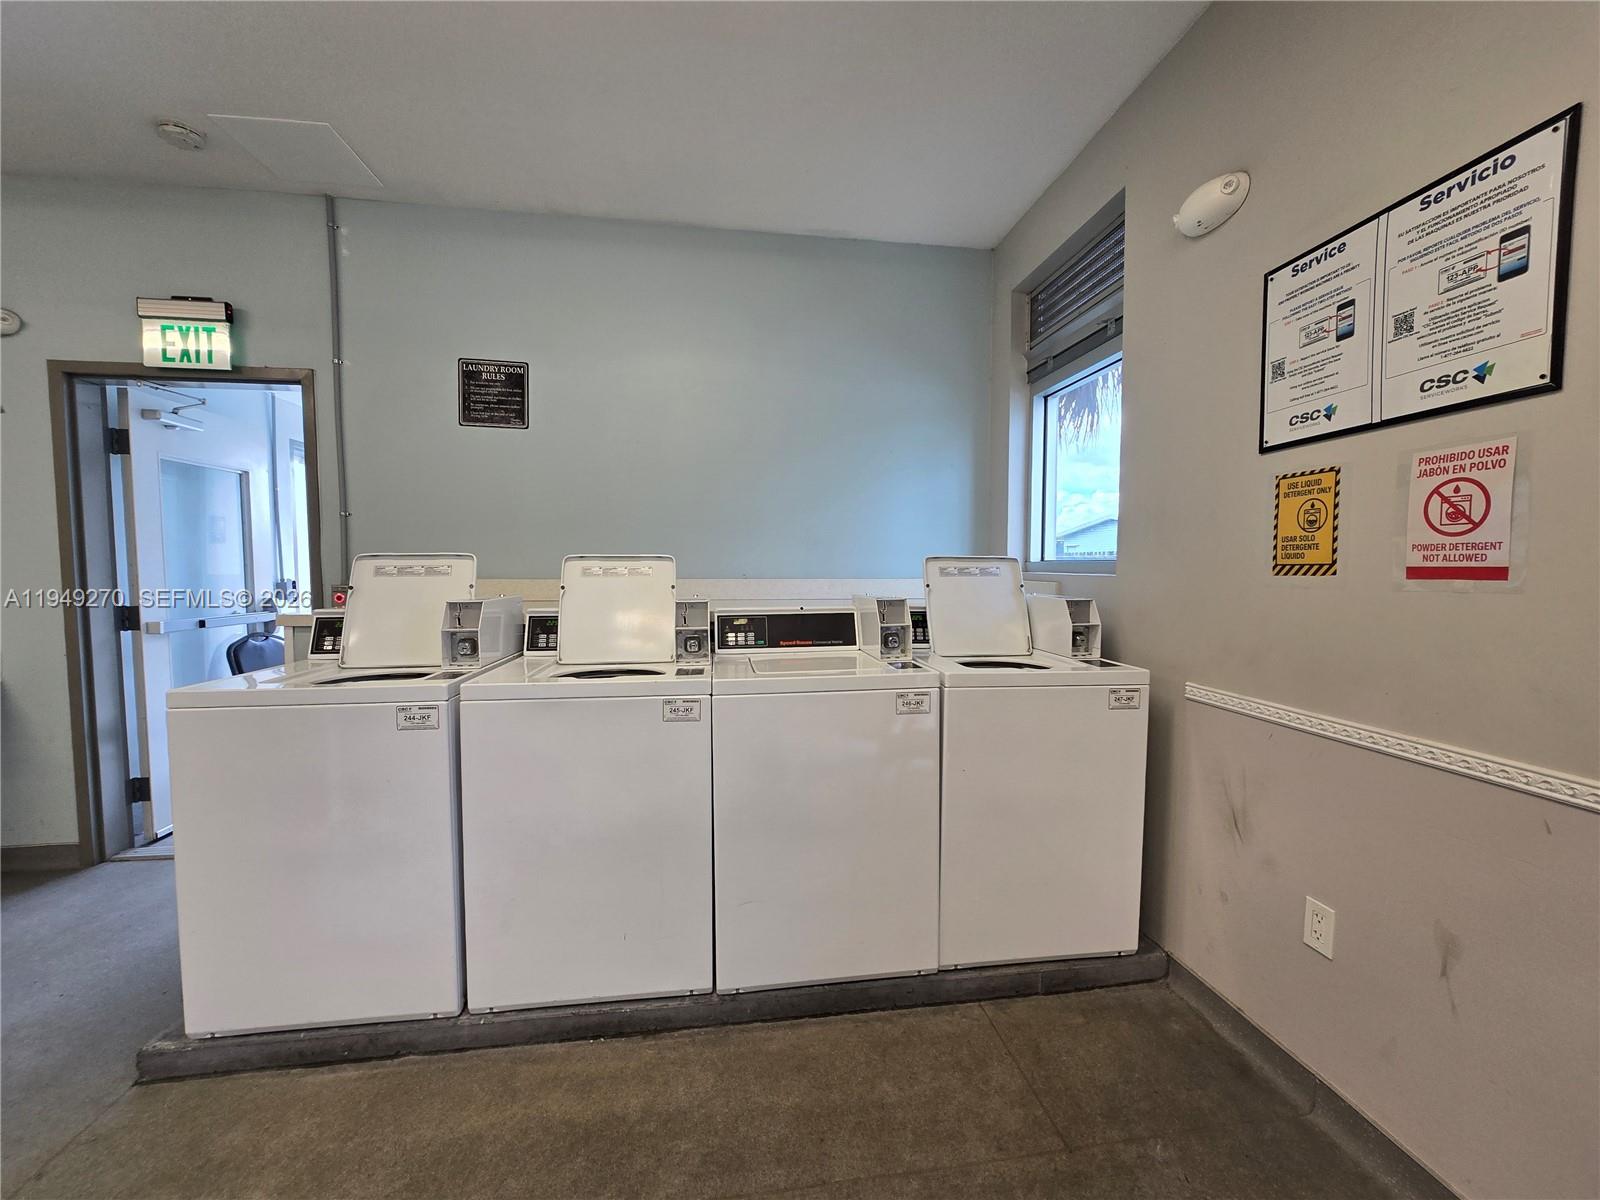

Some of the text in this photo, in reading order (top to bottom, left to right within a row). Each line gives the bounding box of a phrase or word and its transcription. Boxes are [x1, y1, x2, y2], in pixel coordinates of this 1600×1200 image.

[1419, 154, 1516, 212] Servicio
[1404, 213, 1441, 235] SATISFACCION
[1442, 209, 1448, 217] ES
[1450, 190, 1487, 213] IMPORTANTE
[1489, 181, 1506, 194] PARA
[1507, 162, 1545, 185] NOSOTROS
[1427, 201, 1478, 230] FUNCIONAMIENTO
[1479, 182, 1517, 205] APROPIADO
[1415, 233, 1424, 242] LAS
[1425, 219, 1454, 237] MAQUINAS
[1455, 215, 1462, 223] ES
[1463, 201, 1490, 219] NUESTRA
[1492, 183, 1528, 206] PRIORIDAD
[1291, 242, 1346, 278] Service
[1446, 265, 1478, 281] 123-APP
[161, 325, 216, 364] EXIT
[463, 364, 500, 373] LAUNDRY
[1420, 370, 1469, 393] CSC
[1420, 385, 1468, 400] SERVICEWORKS
[1289, 409, 1321, 426] CSC
[1418, 445, 1510, 467] PROHIBIDO USAR
[1416, 458, 1506, 479] JABÓN EN POLVO
[1284, 486, 1332, 498] DETERGENT ONLY
[1287, 479, 1322, 490] USE LIQUID
[1281, 543, 1319, 551] DETERGENTE
[1412, 541, 1503, 552] POWDER DETERGENT
[1422, 553, 1488, 562] NOT ALLOWED
